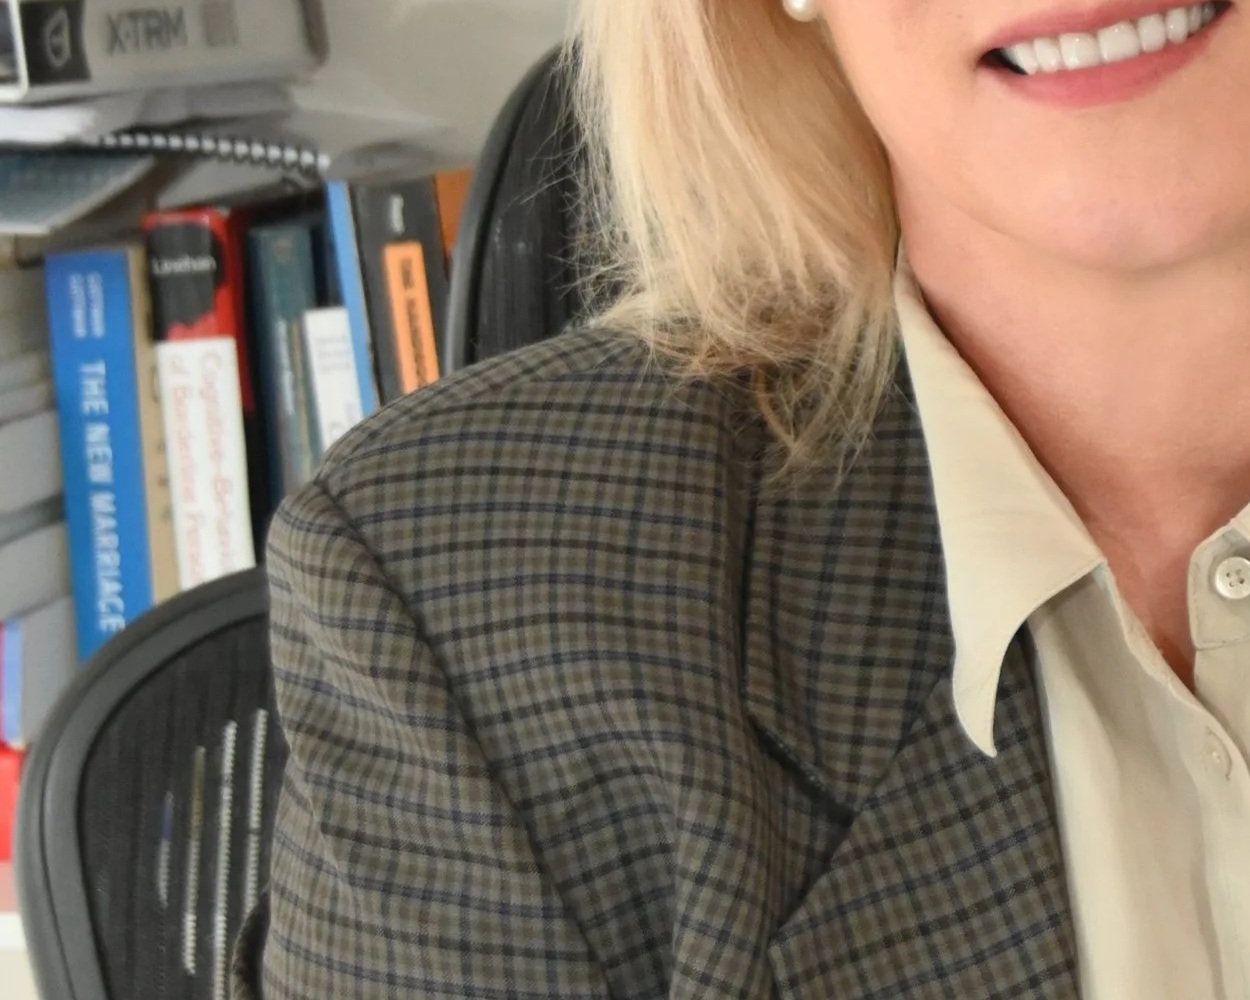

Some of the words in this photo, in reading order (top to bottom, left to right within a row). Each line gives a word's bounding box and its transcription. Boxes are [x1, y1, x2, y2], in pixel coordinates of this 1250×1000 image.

[79, 361, 110, 416] THE
[83, 422, 116, 485] NEW
[89, 492, 127, 633] MARRIAGE
